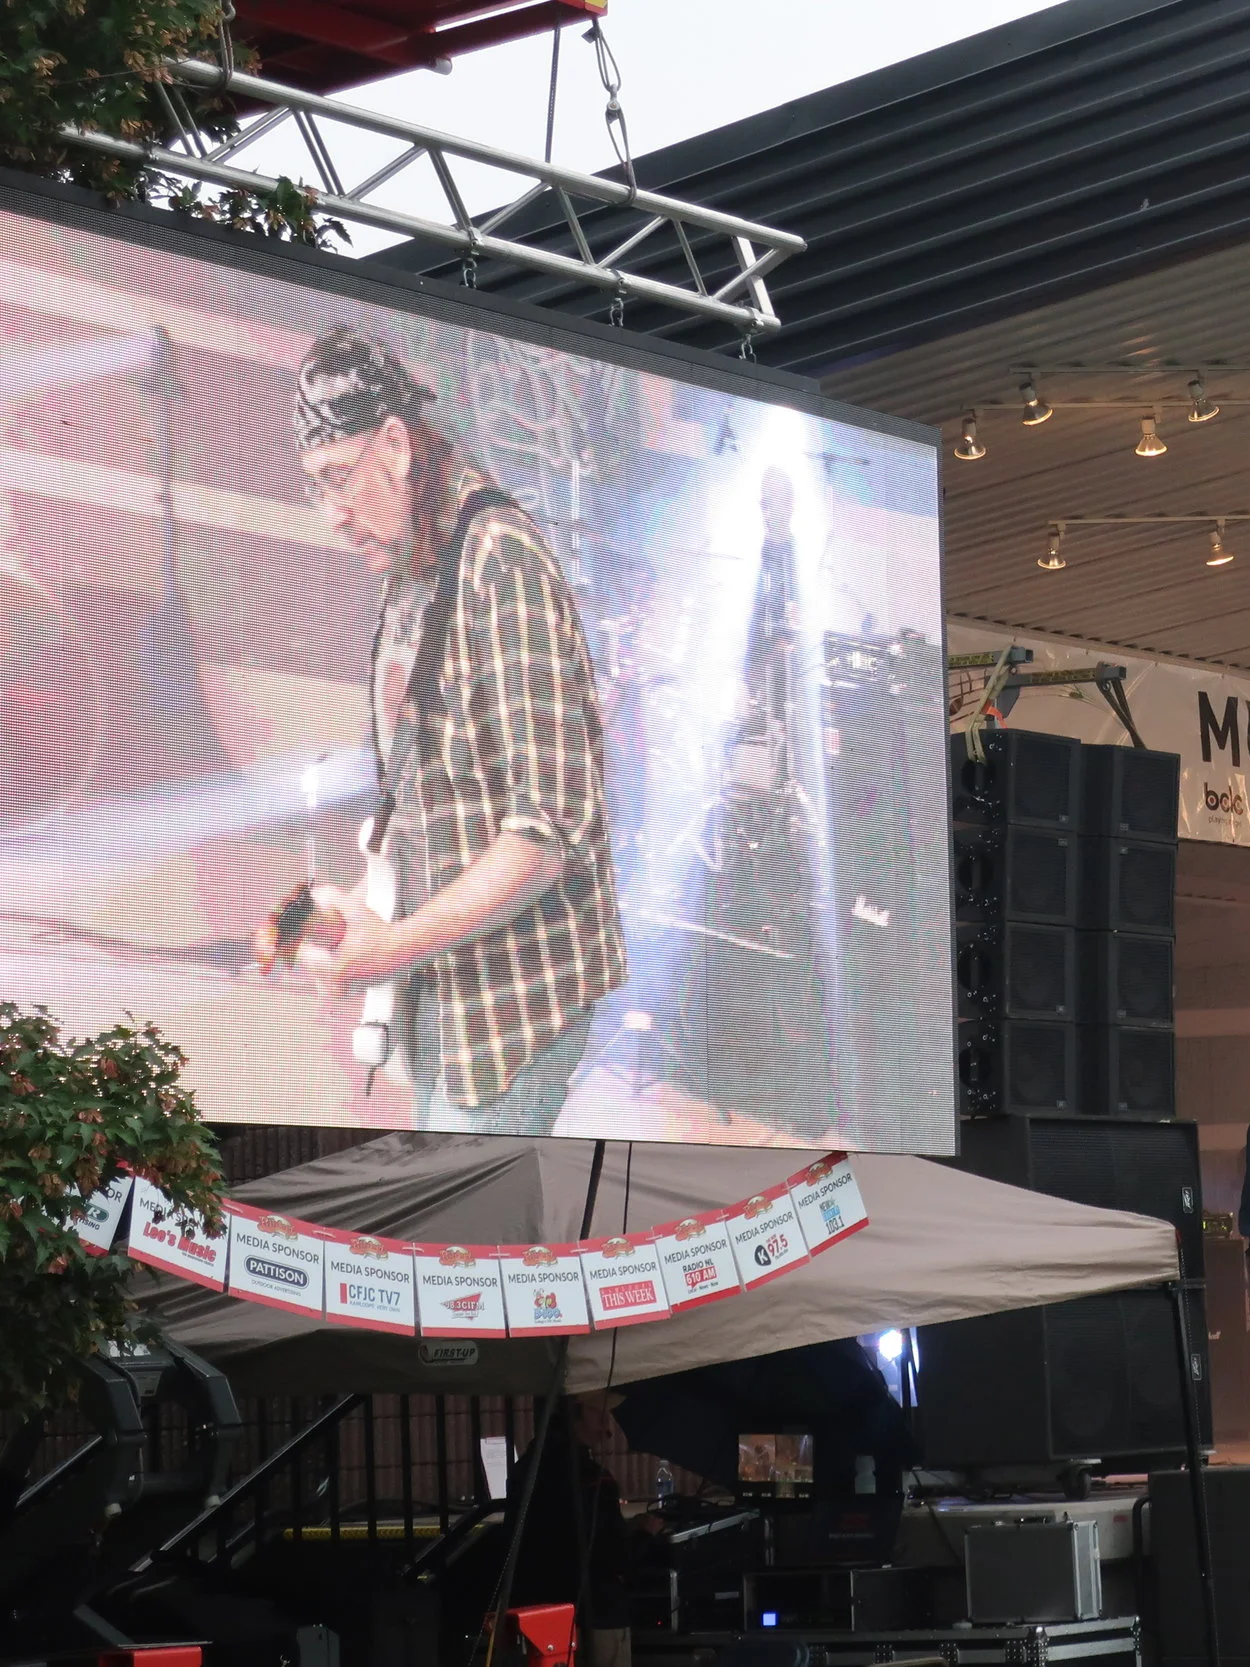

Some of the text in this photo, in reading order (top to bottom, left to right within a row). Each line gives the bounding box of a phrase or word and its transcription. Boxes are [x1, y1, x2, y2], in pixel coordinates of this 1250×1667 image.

[797, 1191, 821, 1210] MEDIA
[820, 1173, 853, 1198] SPONSOR
[735, 1227, 760, 1245] MEDIA
[760, 1211, 794, 1233] SPONSOR
[825, 1215, 845, 1235] 103.1
[143, 1221, 177, 1247] Lee's
[177, 1234, 217, 1263] Music
[236, 1233, 319, 1264] MEDIA SPONSOR
[664, 1239, 727, 1265] MEDIA SPONSOR
[767, 1233, 788, 1257] 97.5
[250, 1260, 305, 1285] PATTISON
[330, 1261, 410, 1283] MEDIA SPONSOR
[589, 1262, 658, 1280] MEDIA SPONSOR
[682, 1258, 714, 1273] RADIO NL
[686, 1268, 716, 1285] 610 AM
[422, 1275, 498, 1287] MEDIA SPONSOR
[508, 1272, 579, 1283] MEDIA SPONSOR
[349, 1284, 401, 1306] CFJC TV7
[602, 1292, 626, 1308] THIS
[625, 1287, 654, 1304] WEEK
